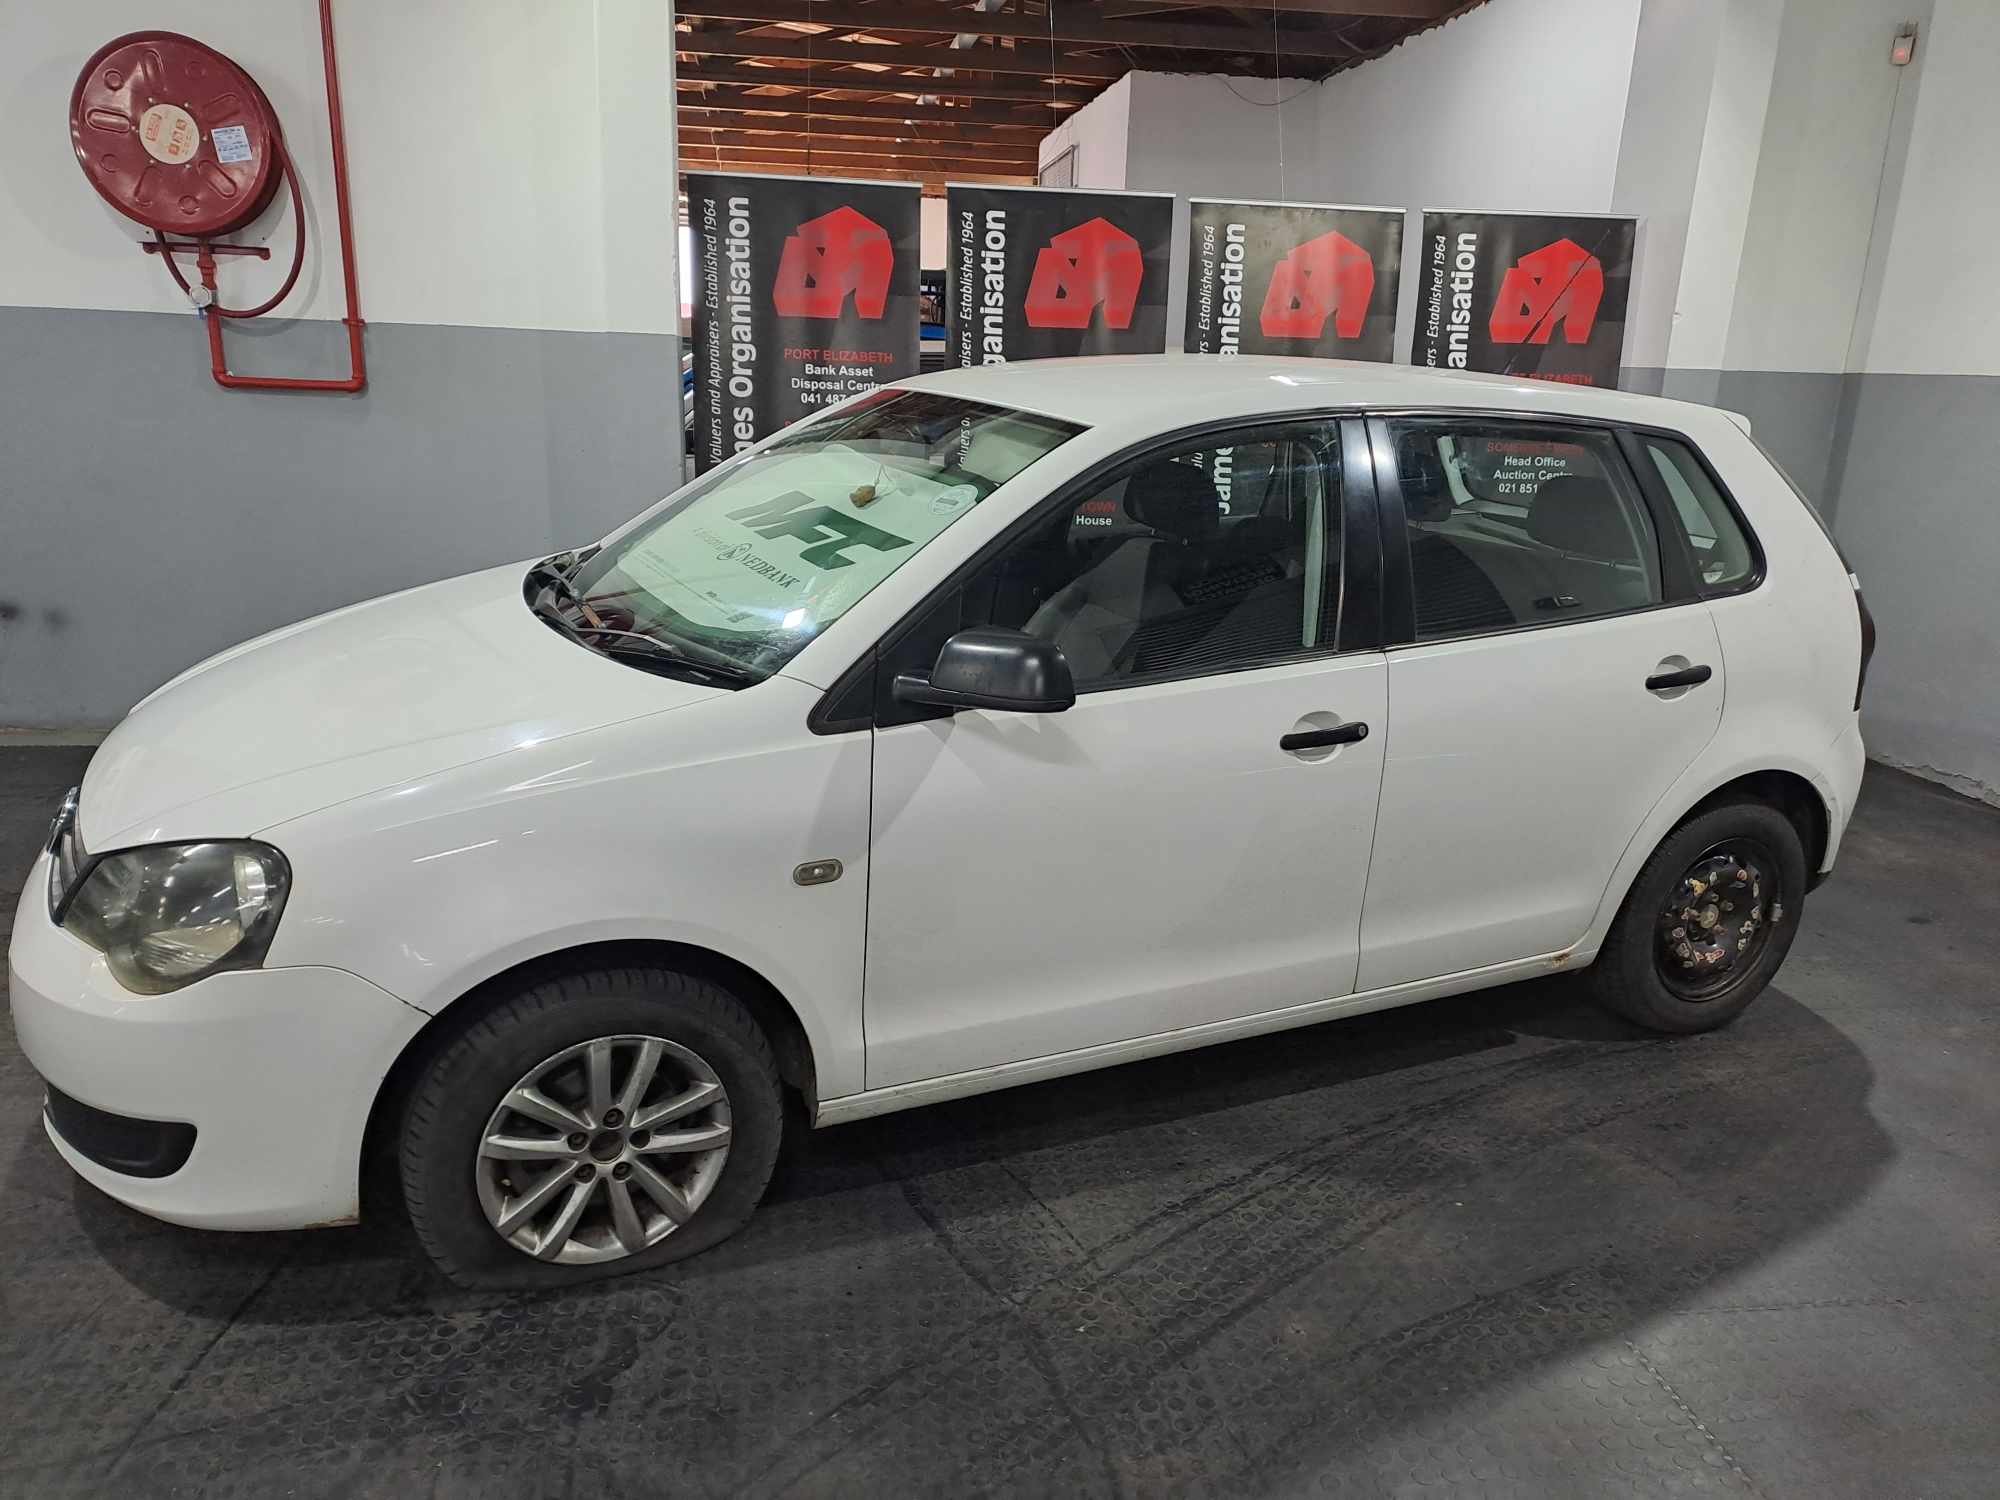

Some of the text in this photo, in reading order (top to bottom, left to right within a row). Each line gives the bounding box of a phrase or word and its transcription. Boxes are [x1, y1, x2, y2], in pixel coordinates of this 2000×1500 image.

[703, 198, 717, 231] 1964
[961, 211, 974, 243] 1964
[1202, 225, 1215, 256] 1964
[1434, 235, 1446, 264] 1964
[703, 233, 719, 309] Established
[959, 247, 974, 320] Established
[725, 196, 757, 398] Organisation
[979, 209, 1007, 368] ganisation
[1198, 259, 1214, 330] Established
[1217, 223, 1246, 356] anisation
[1426, 268, 1444, 338] Established
[1446, 232, 1477, 369] anisation
[706, 319, 723, 388] Appraisers
[783, 348, 893, 363] PORT ELIZABETH
[958, 330, 972, 368] aisers
[791, 377, 844, 391] Disposal
[804, 363, 874, 377] Bank Asset
[708, 389, 721, 415] and
[800, 393, 821, 404] 041
[709, 418, 723, 464] Valuers
[1493, 469, 1535, 480] Auction
[1504, 455, 1566, 467] Head Office
[1498, 483, 1538, 494] 021 851
[1075, 514, 1113, 526] House
[735, 552, 801, 589] NEDBANK
